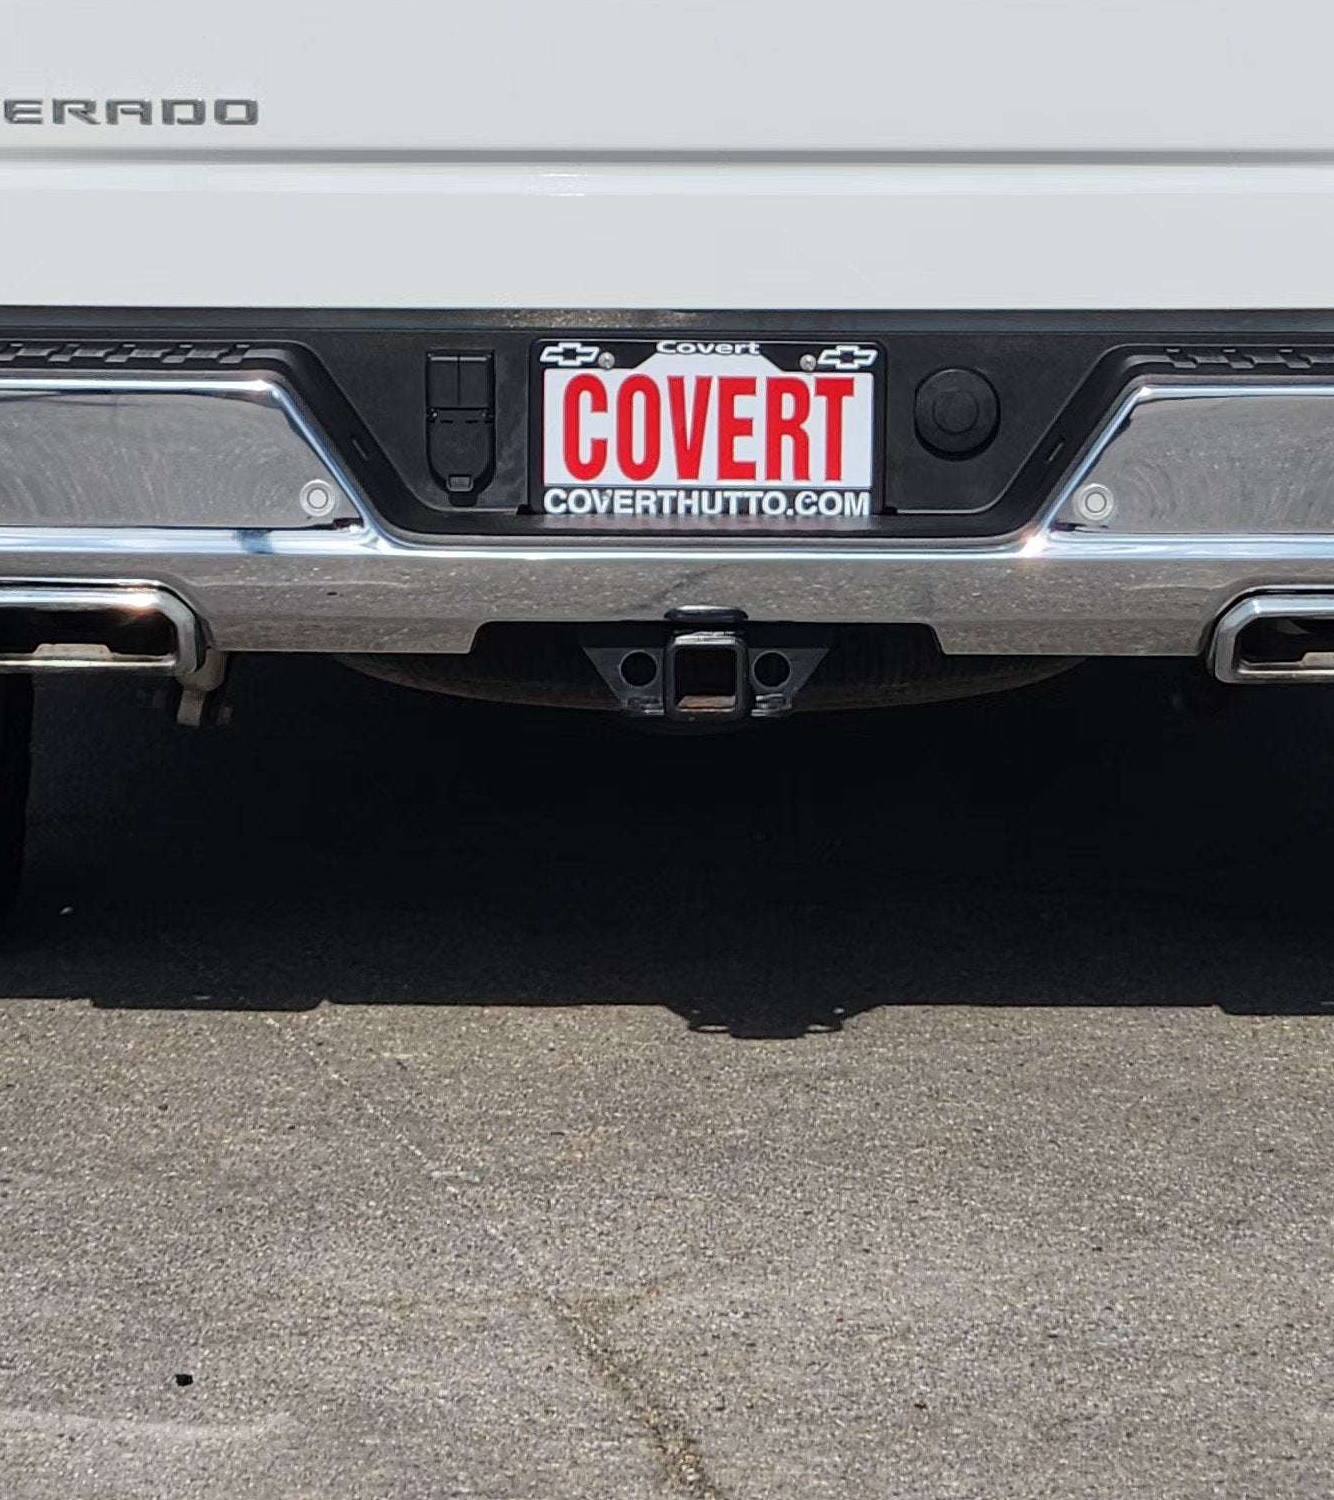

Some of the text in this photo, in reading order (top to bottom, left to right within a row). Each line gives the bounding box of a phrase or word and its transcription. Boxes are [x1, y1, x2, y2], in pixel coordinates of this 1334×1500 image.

[656, 340, 760, 355] Covert
[563, 373, 855, 481] COVERT
[543, 488, 870, 517] COVERTHUTTO.COM
